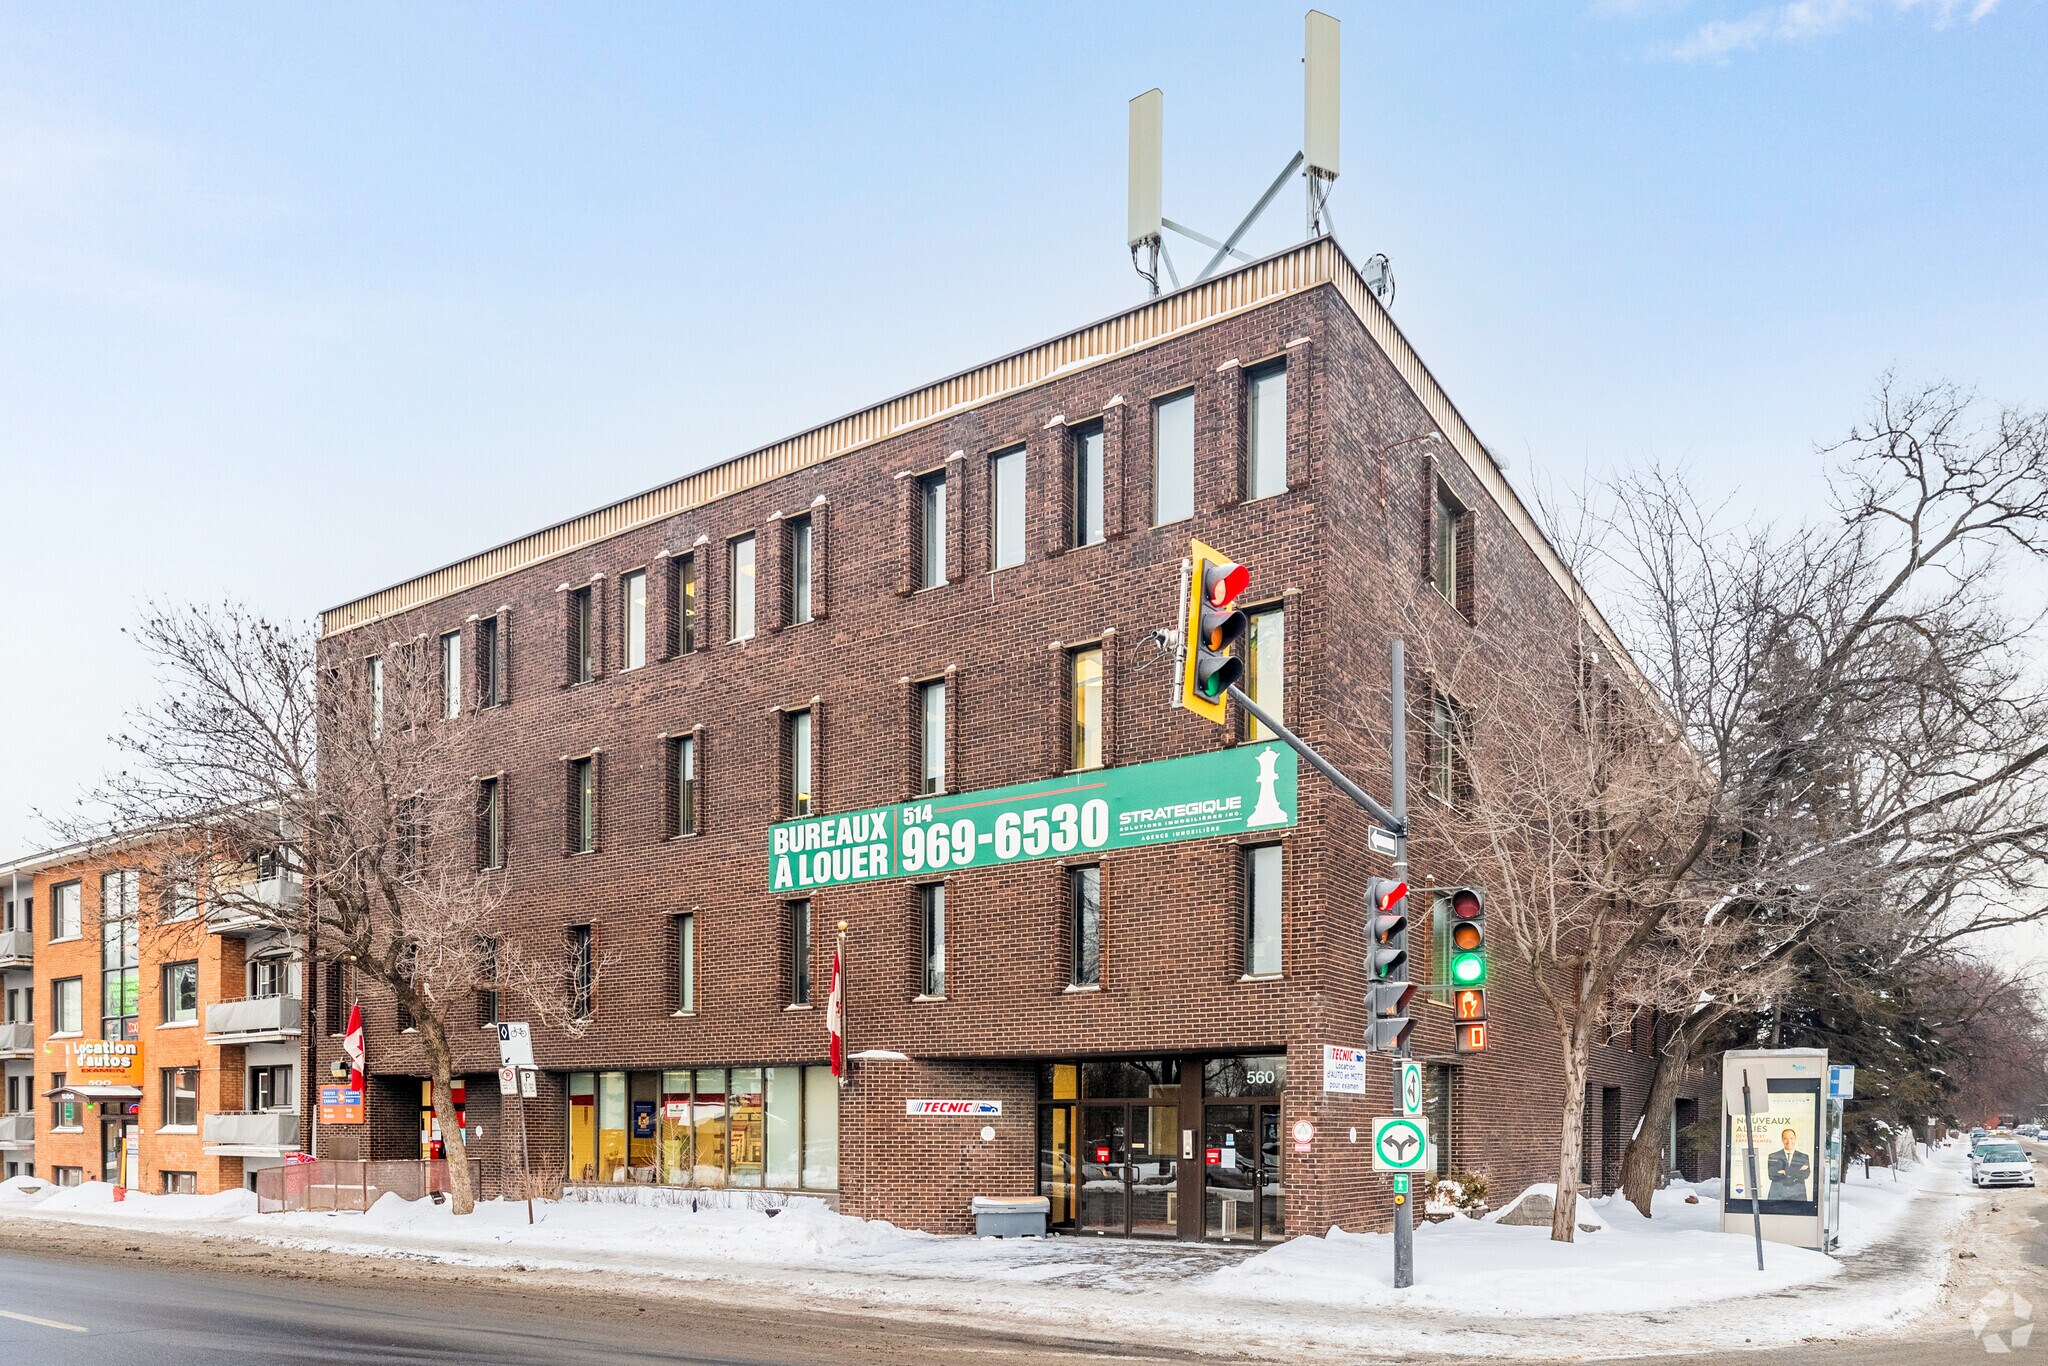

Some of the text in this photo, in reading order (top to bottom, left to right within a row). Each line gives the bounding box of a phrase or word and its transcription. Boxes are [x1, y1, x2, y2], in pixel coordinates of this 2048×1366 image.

[903, 804, 933, 825] 514
[1119, 796, 1241, 824] STRATEGIQUE
[1119, 822, 1162, 832] SOLUTIONS
[1165, 813, 1222, 826] IMMOBILIÈRES
[774, 811, 888, 855] BUREAUX
[902, 798, 1109, 872] 969-6530
[1141, 826, 1220, 841] AGENCE IMMOBILIÈRE
[774, 843, 888, 889] À LOUER
[73, 1041, 137, 1054] Location
[1332, 1048, 1353, 1061] TECNIC
[77, 1053, 131, 1067] d'autos
[1336, 1062, 1355, 1070] Location
[1246, 1070, 1275, 1084] 560
[923, 1102, 973, 1113] TECNIC
[1736, 1117, 1791, 1125] NUVEAUX
[1735, 1124, 1768, 1133] ALIÉS
